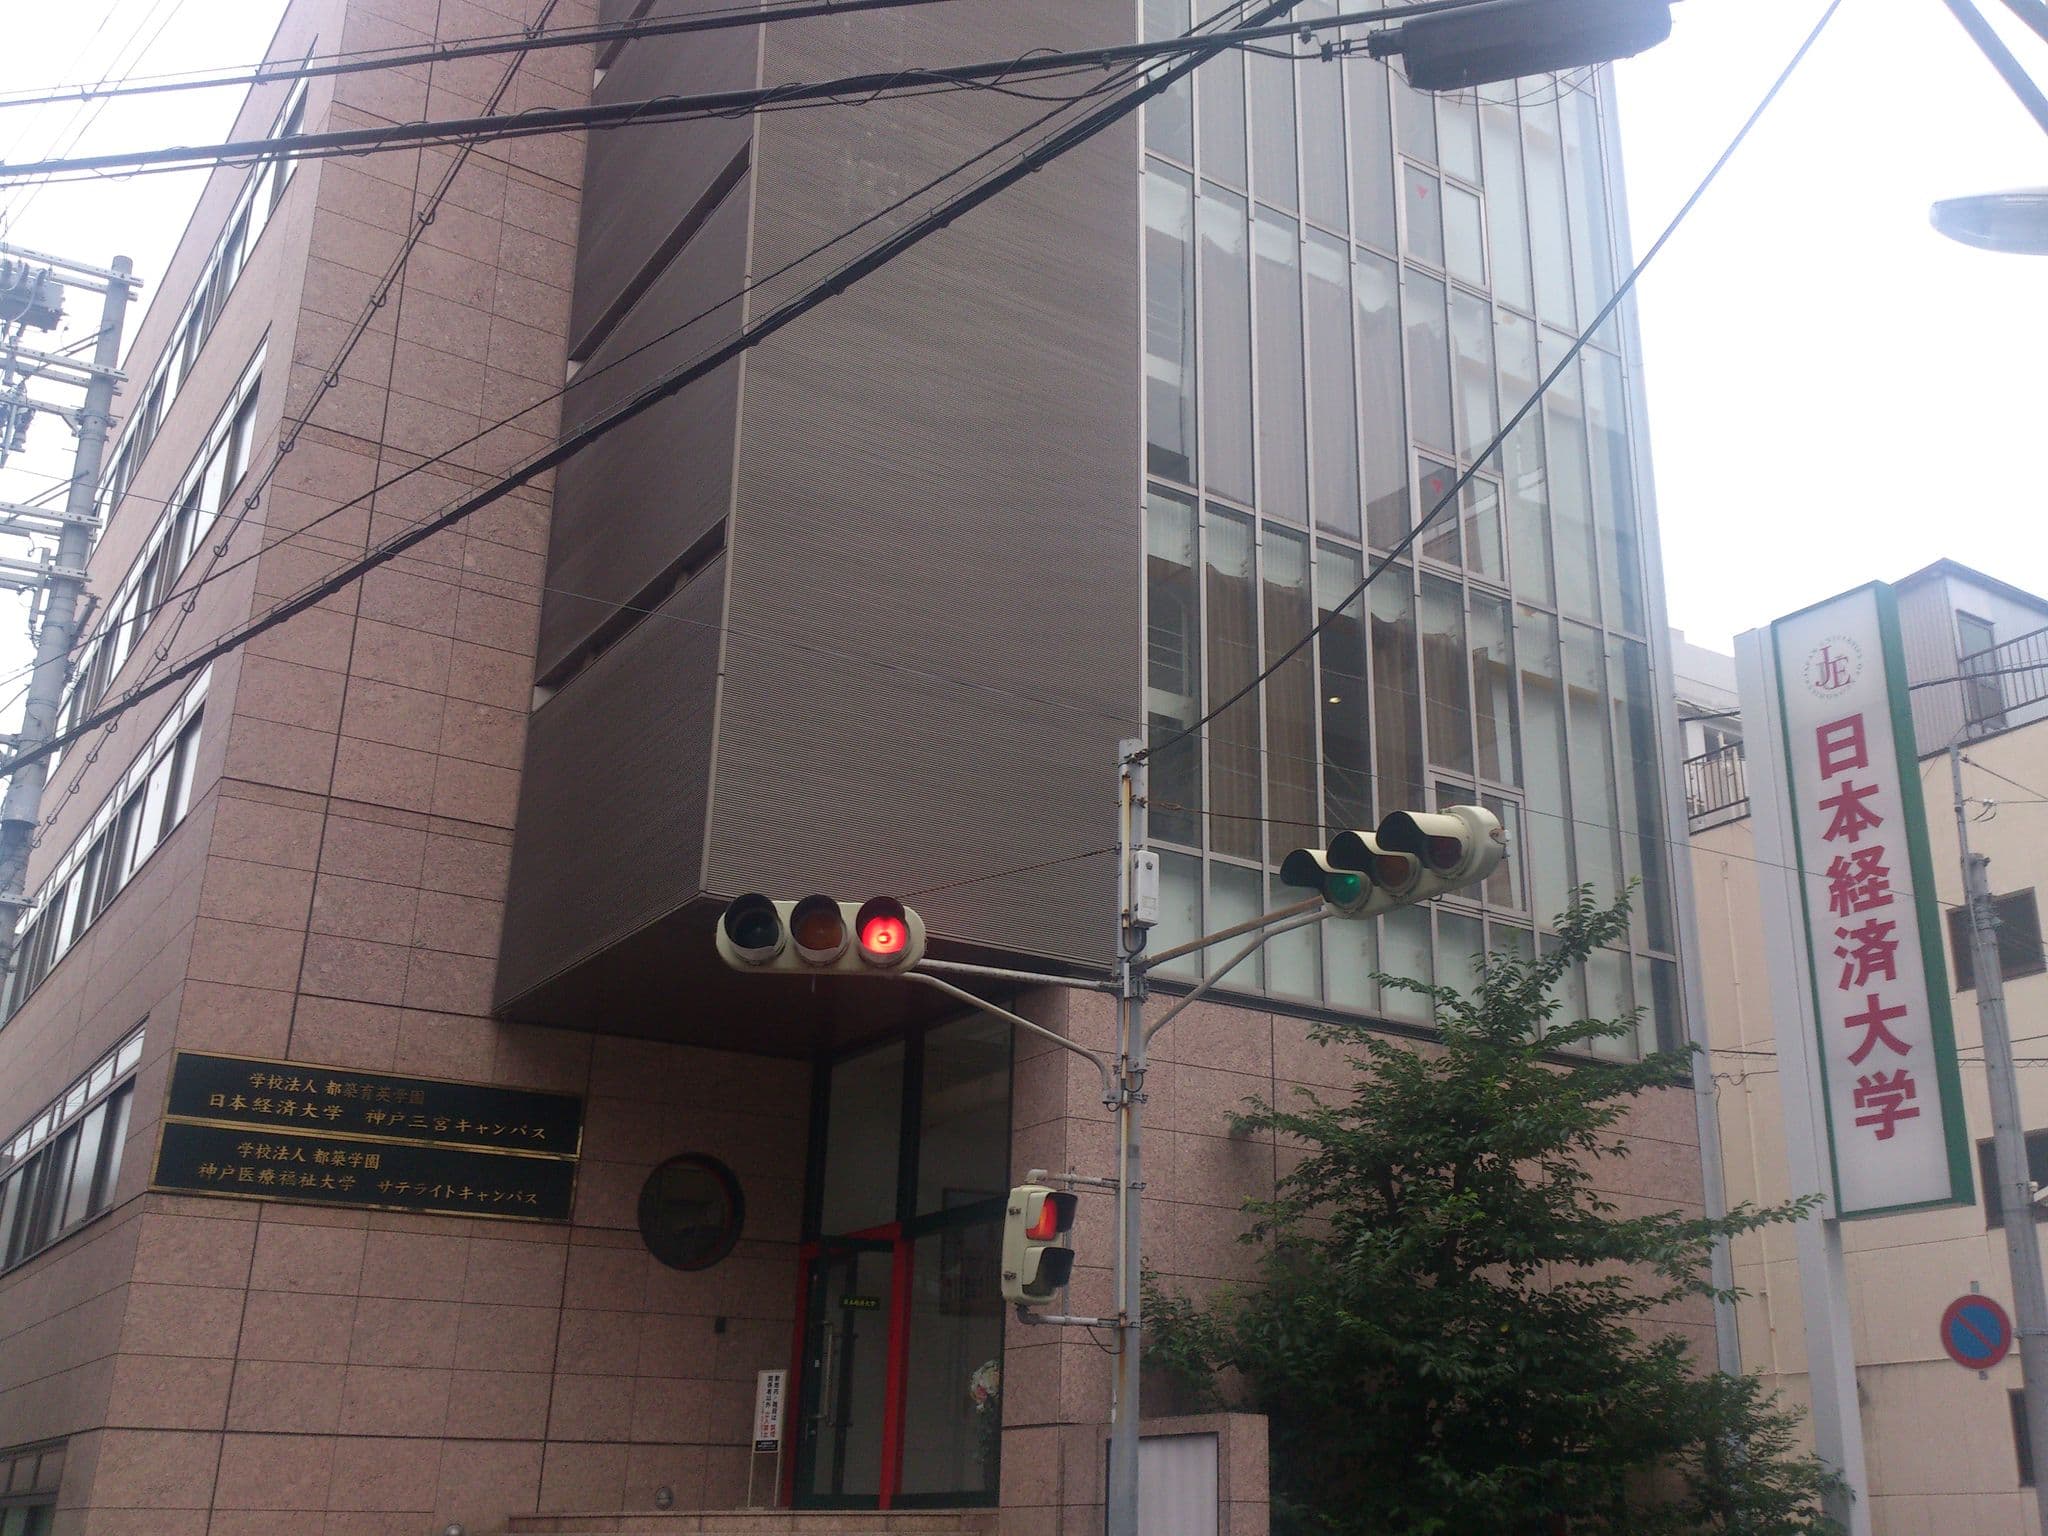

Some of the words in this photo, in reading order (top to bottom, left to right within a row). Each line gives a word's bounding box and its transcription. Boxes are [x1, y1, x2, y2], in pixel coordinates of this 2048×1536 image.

[1816, 713, 1920, 1141] 日本経済大学
[249, 1072, 317, 1094] 学校法人
[208, 1093, 345, 1121] 日本経済大学
[365, 1109, 547, 1140] 神戸三宮キャンパス
[237, 1142, 306, 1163] 学校法人
[312, 1147, 381, 1170] 都築学園
[198, 1162, 357, 1192] 神戸医療福祉大学
[377, 1179, 538, 1205] サテライトキャンパス
